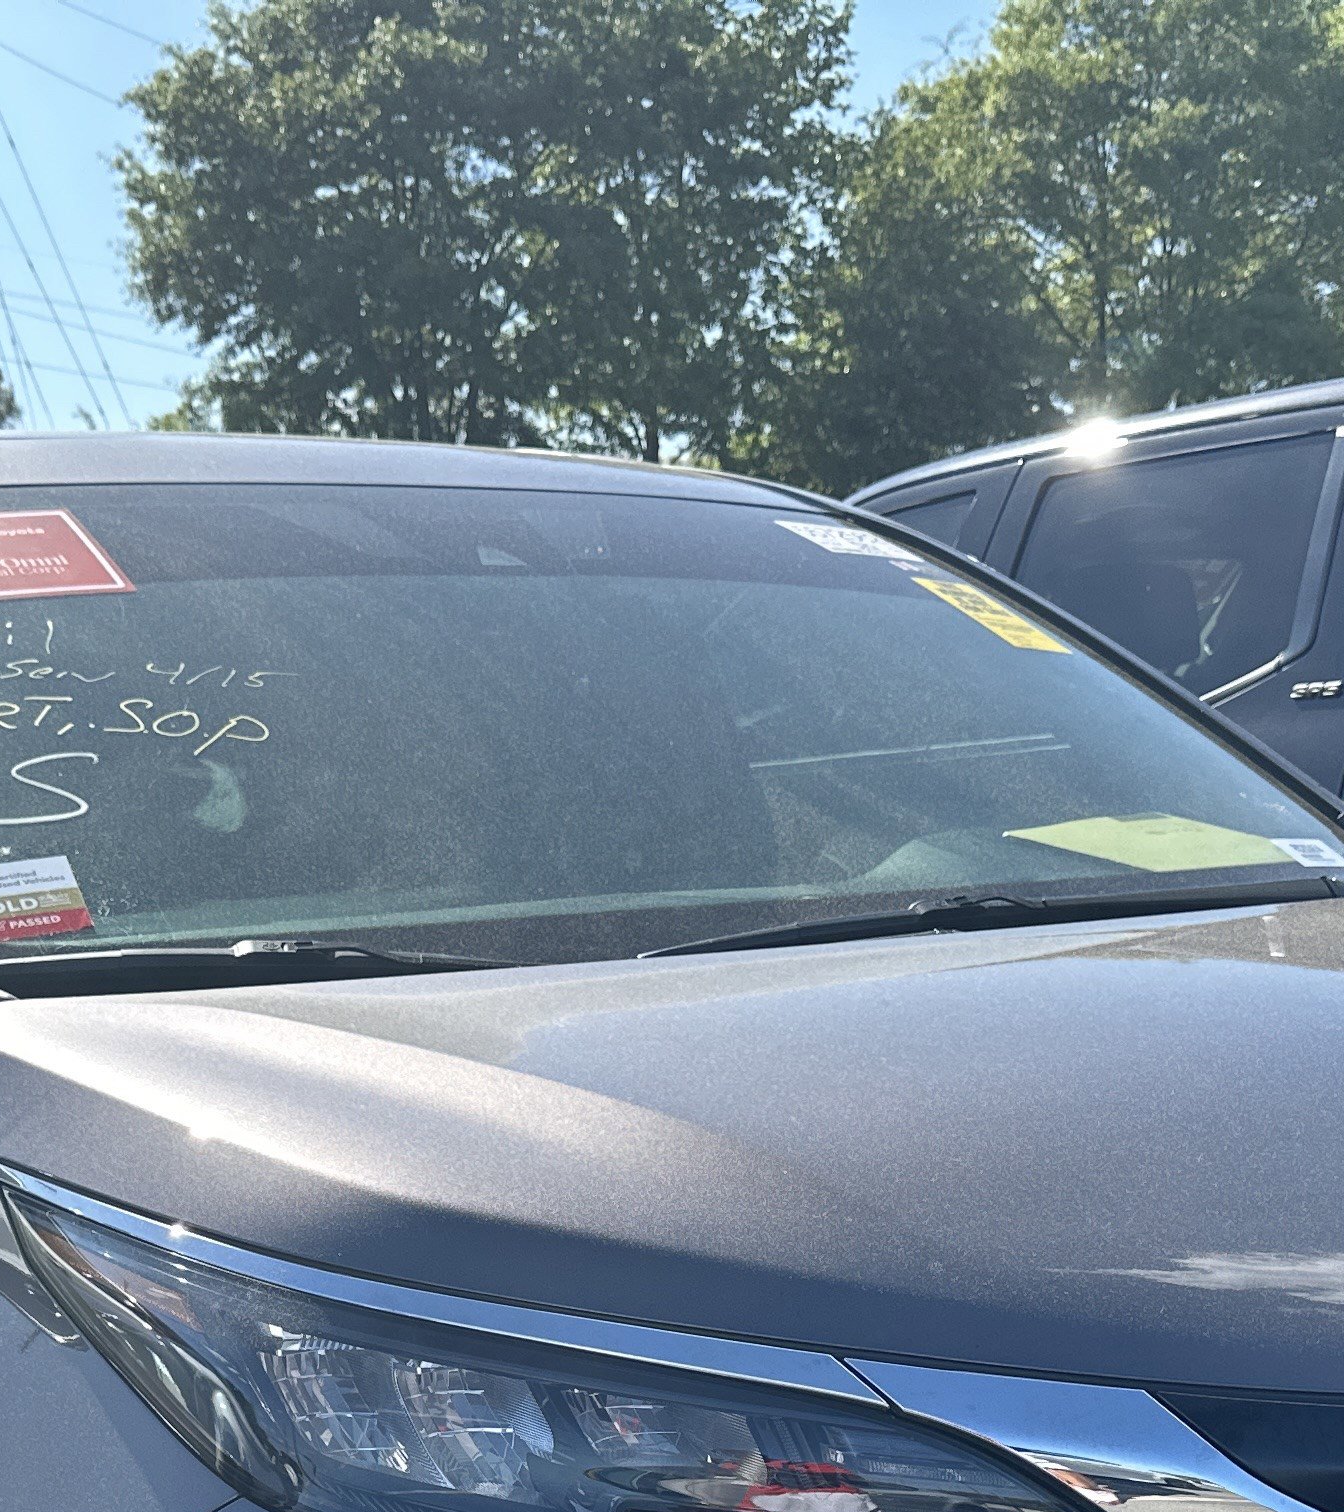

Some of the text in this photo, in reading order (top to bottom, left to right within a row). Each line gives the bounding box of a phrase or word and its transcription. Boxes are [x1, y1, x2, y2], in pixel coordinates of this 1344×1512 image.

[145, 662, 301, 688] 4/15
[22, 874, 66, 886] Vehicles
[8, 915, 62, 930] PASSED
